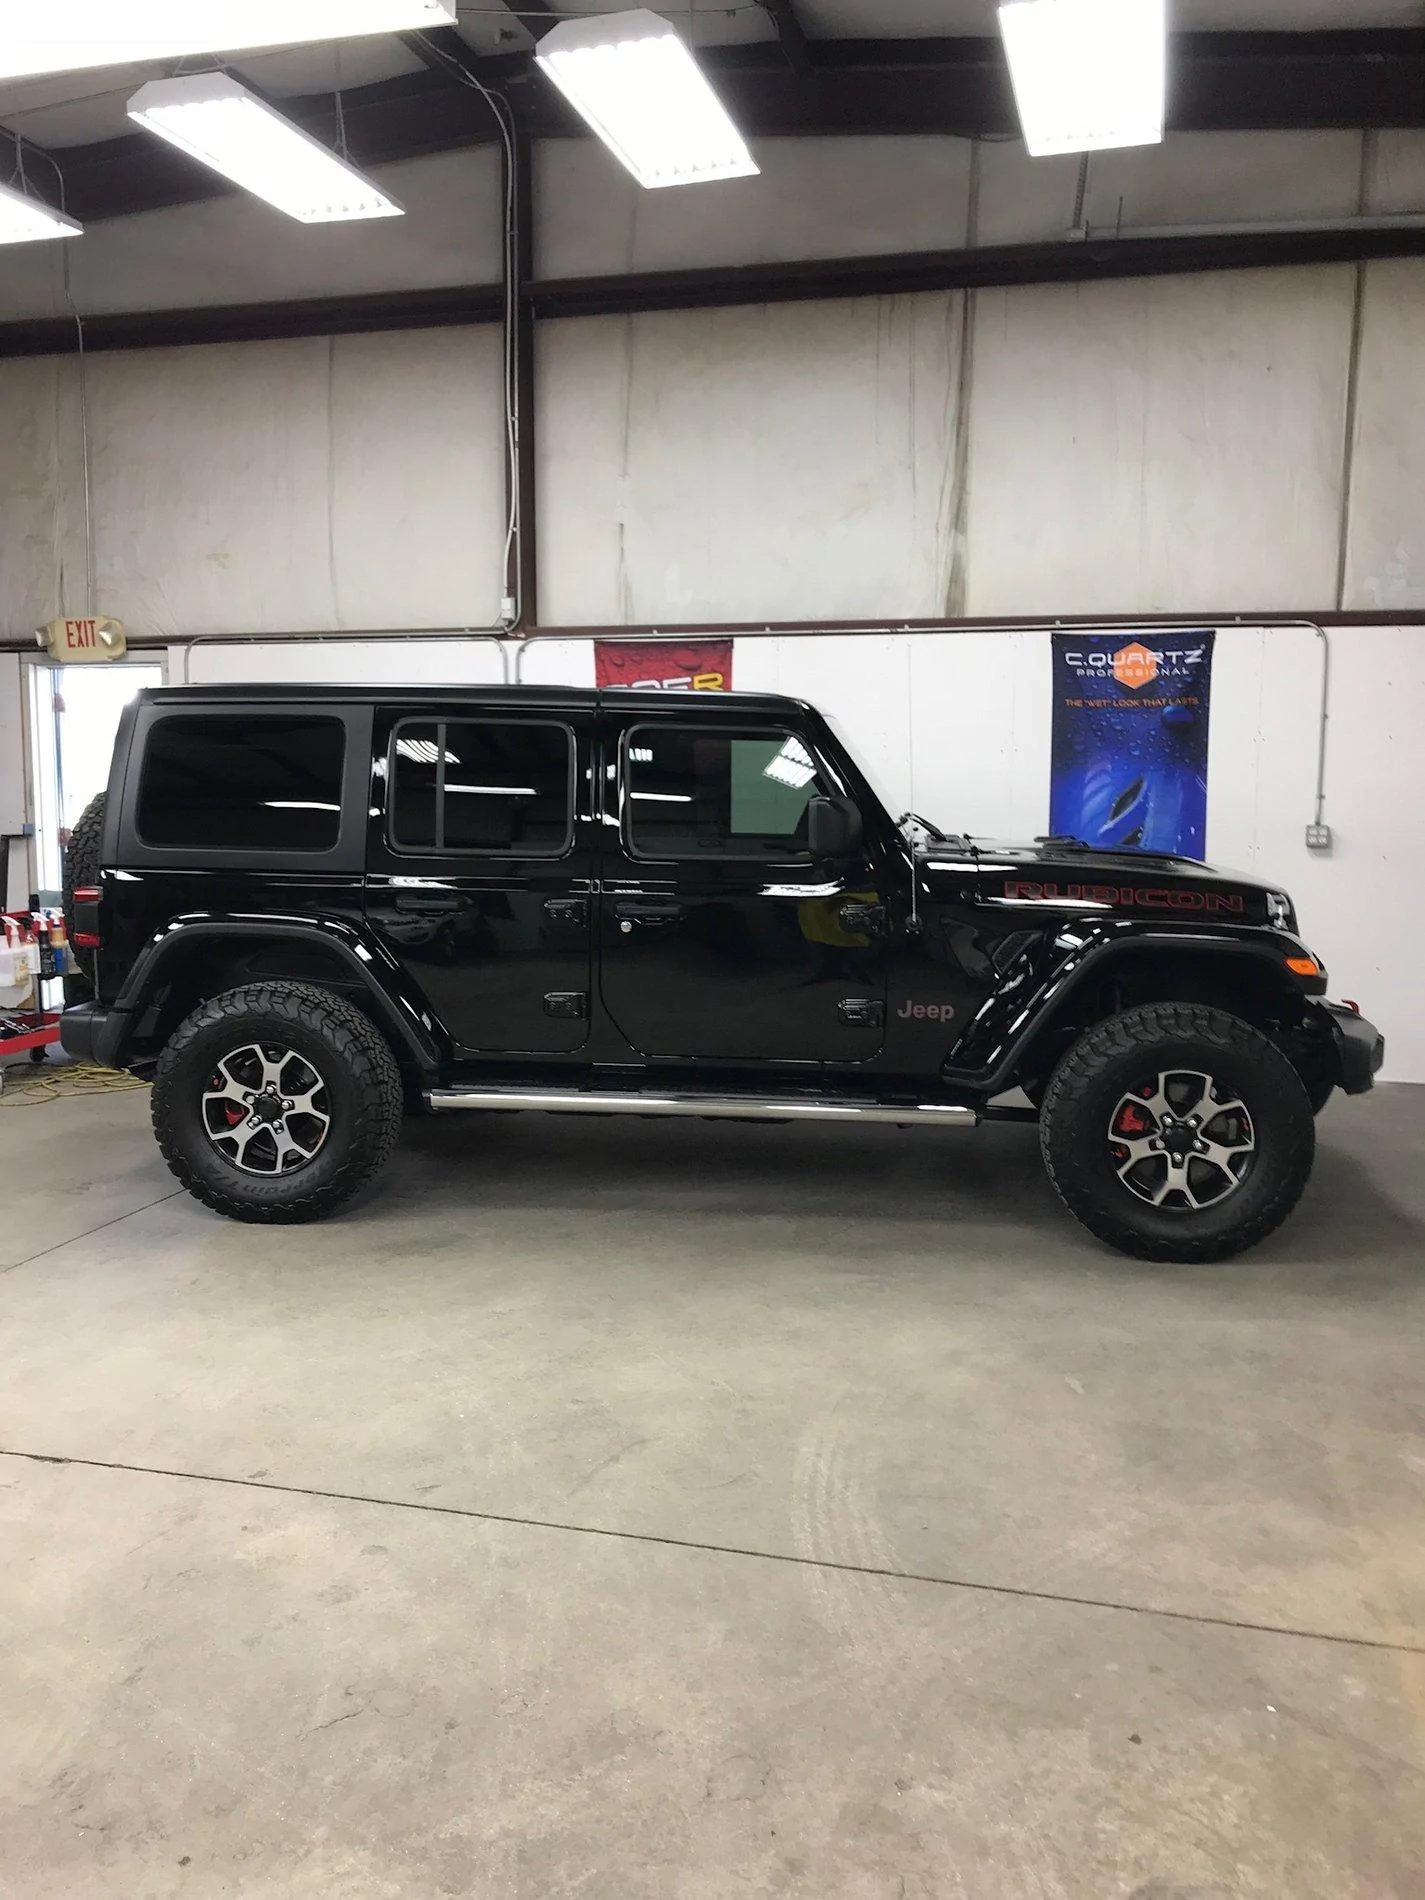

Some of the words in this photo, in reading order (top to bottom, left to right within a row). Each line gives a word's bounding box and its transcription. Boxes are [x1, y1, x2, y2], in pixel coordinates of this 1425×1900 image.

[65, 620, 96, 648] EXIT
[1076, 667, 1189, 677] PROFESSIONAL
[1065, 699, 1083, 707] THE
[1004, 881, 1243, 912] RUBICON
[897, 1000, 954, 1022] Jeep
